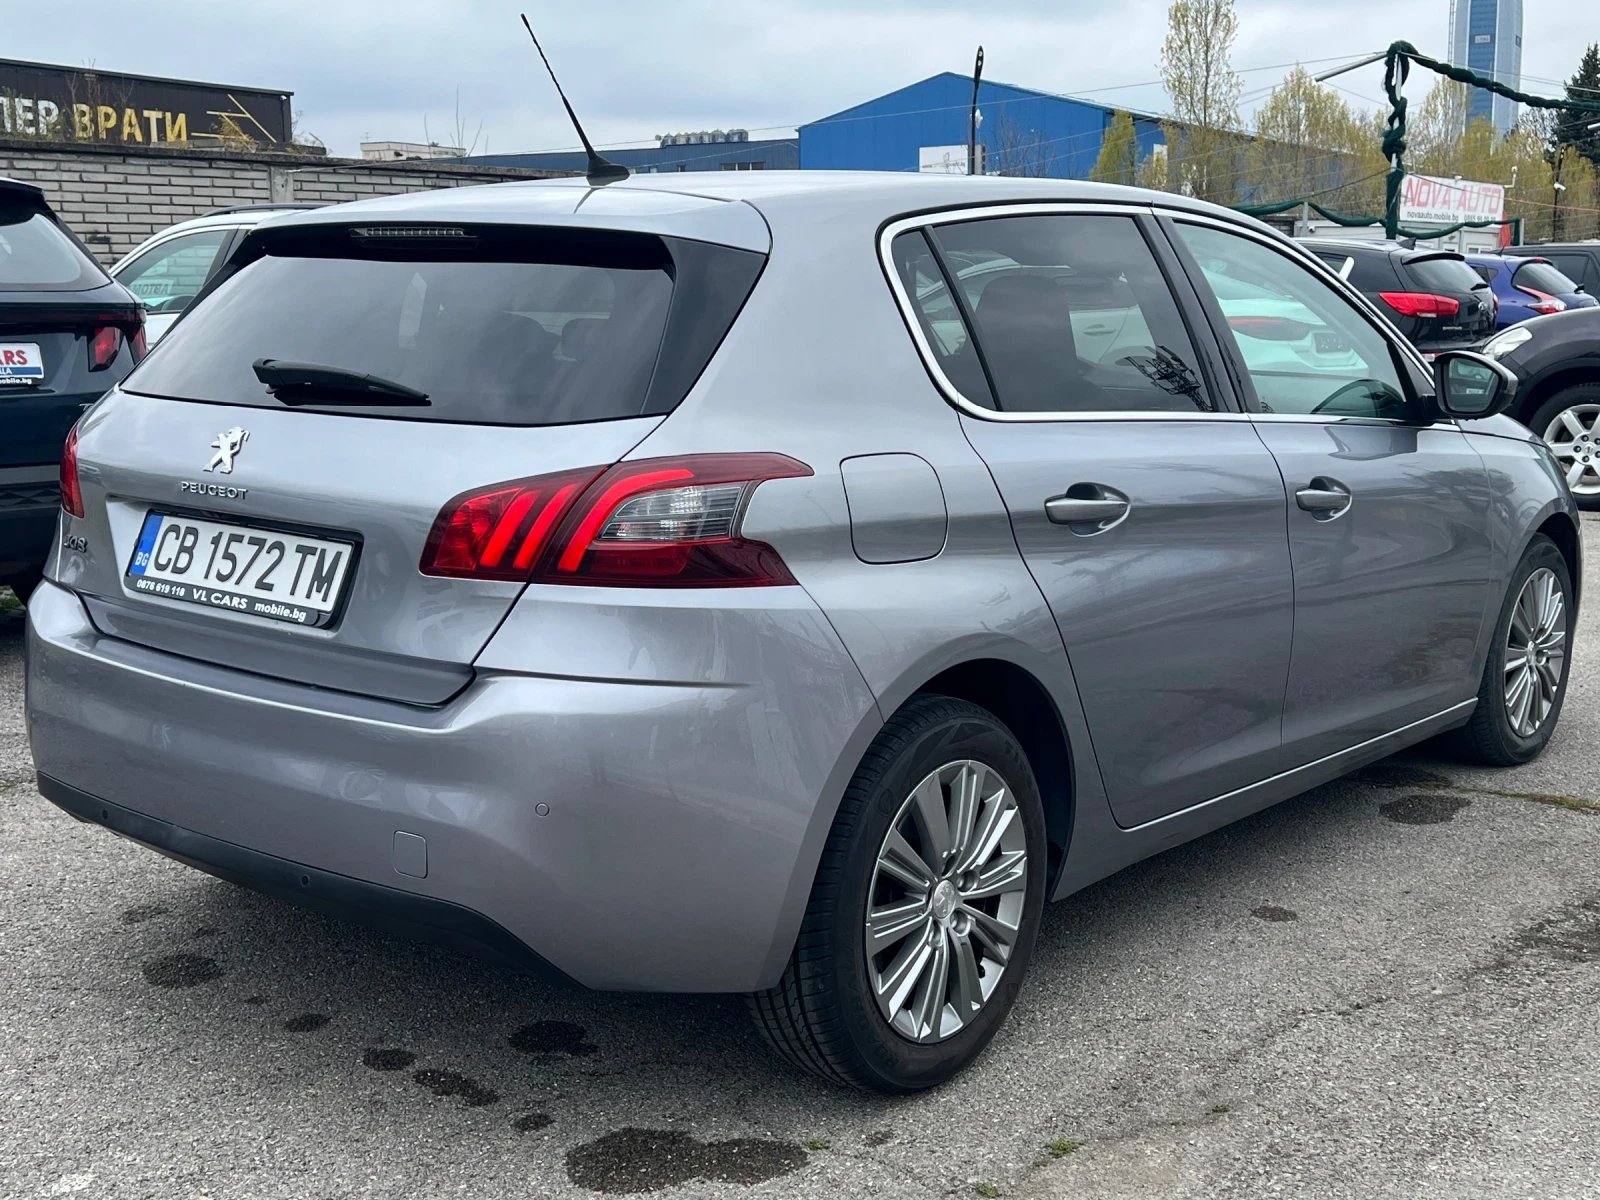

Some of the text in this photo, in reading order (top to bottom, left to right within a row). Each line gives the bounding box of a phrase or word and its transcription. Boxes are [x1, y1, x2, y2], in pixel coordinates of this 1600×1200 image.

[73, 103, 188, 143] ВРАТИ
[1404, 177, 1502, 214] NOVA AUTO
[0, 350, 28, 365] RS
[0, 377, 32, 385] obile.bg
[181, 481, 248, 499] PEUGEOT
[135, 551, 150, 566] BG
[153, 523, 343, 602] CB 1572 TM
[156, 581, 170, 593] 619
[171, 583, 186, 597] 118
[192, 588, 207, 602] VL
[210, 592, 249, 610] CARS
[254, 602, 307, 623] mobile.bg
